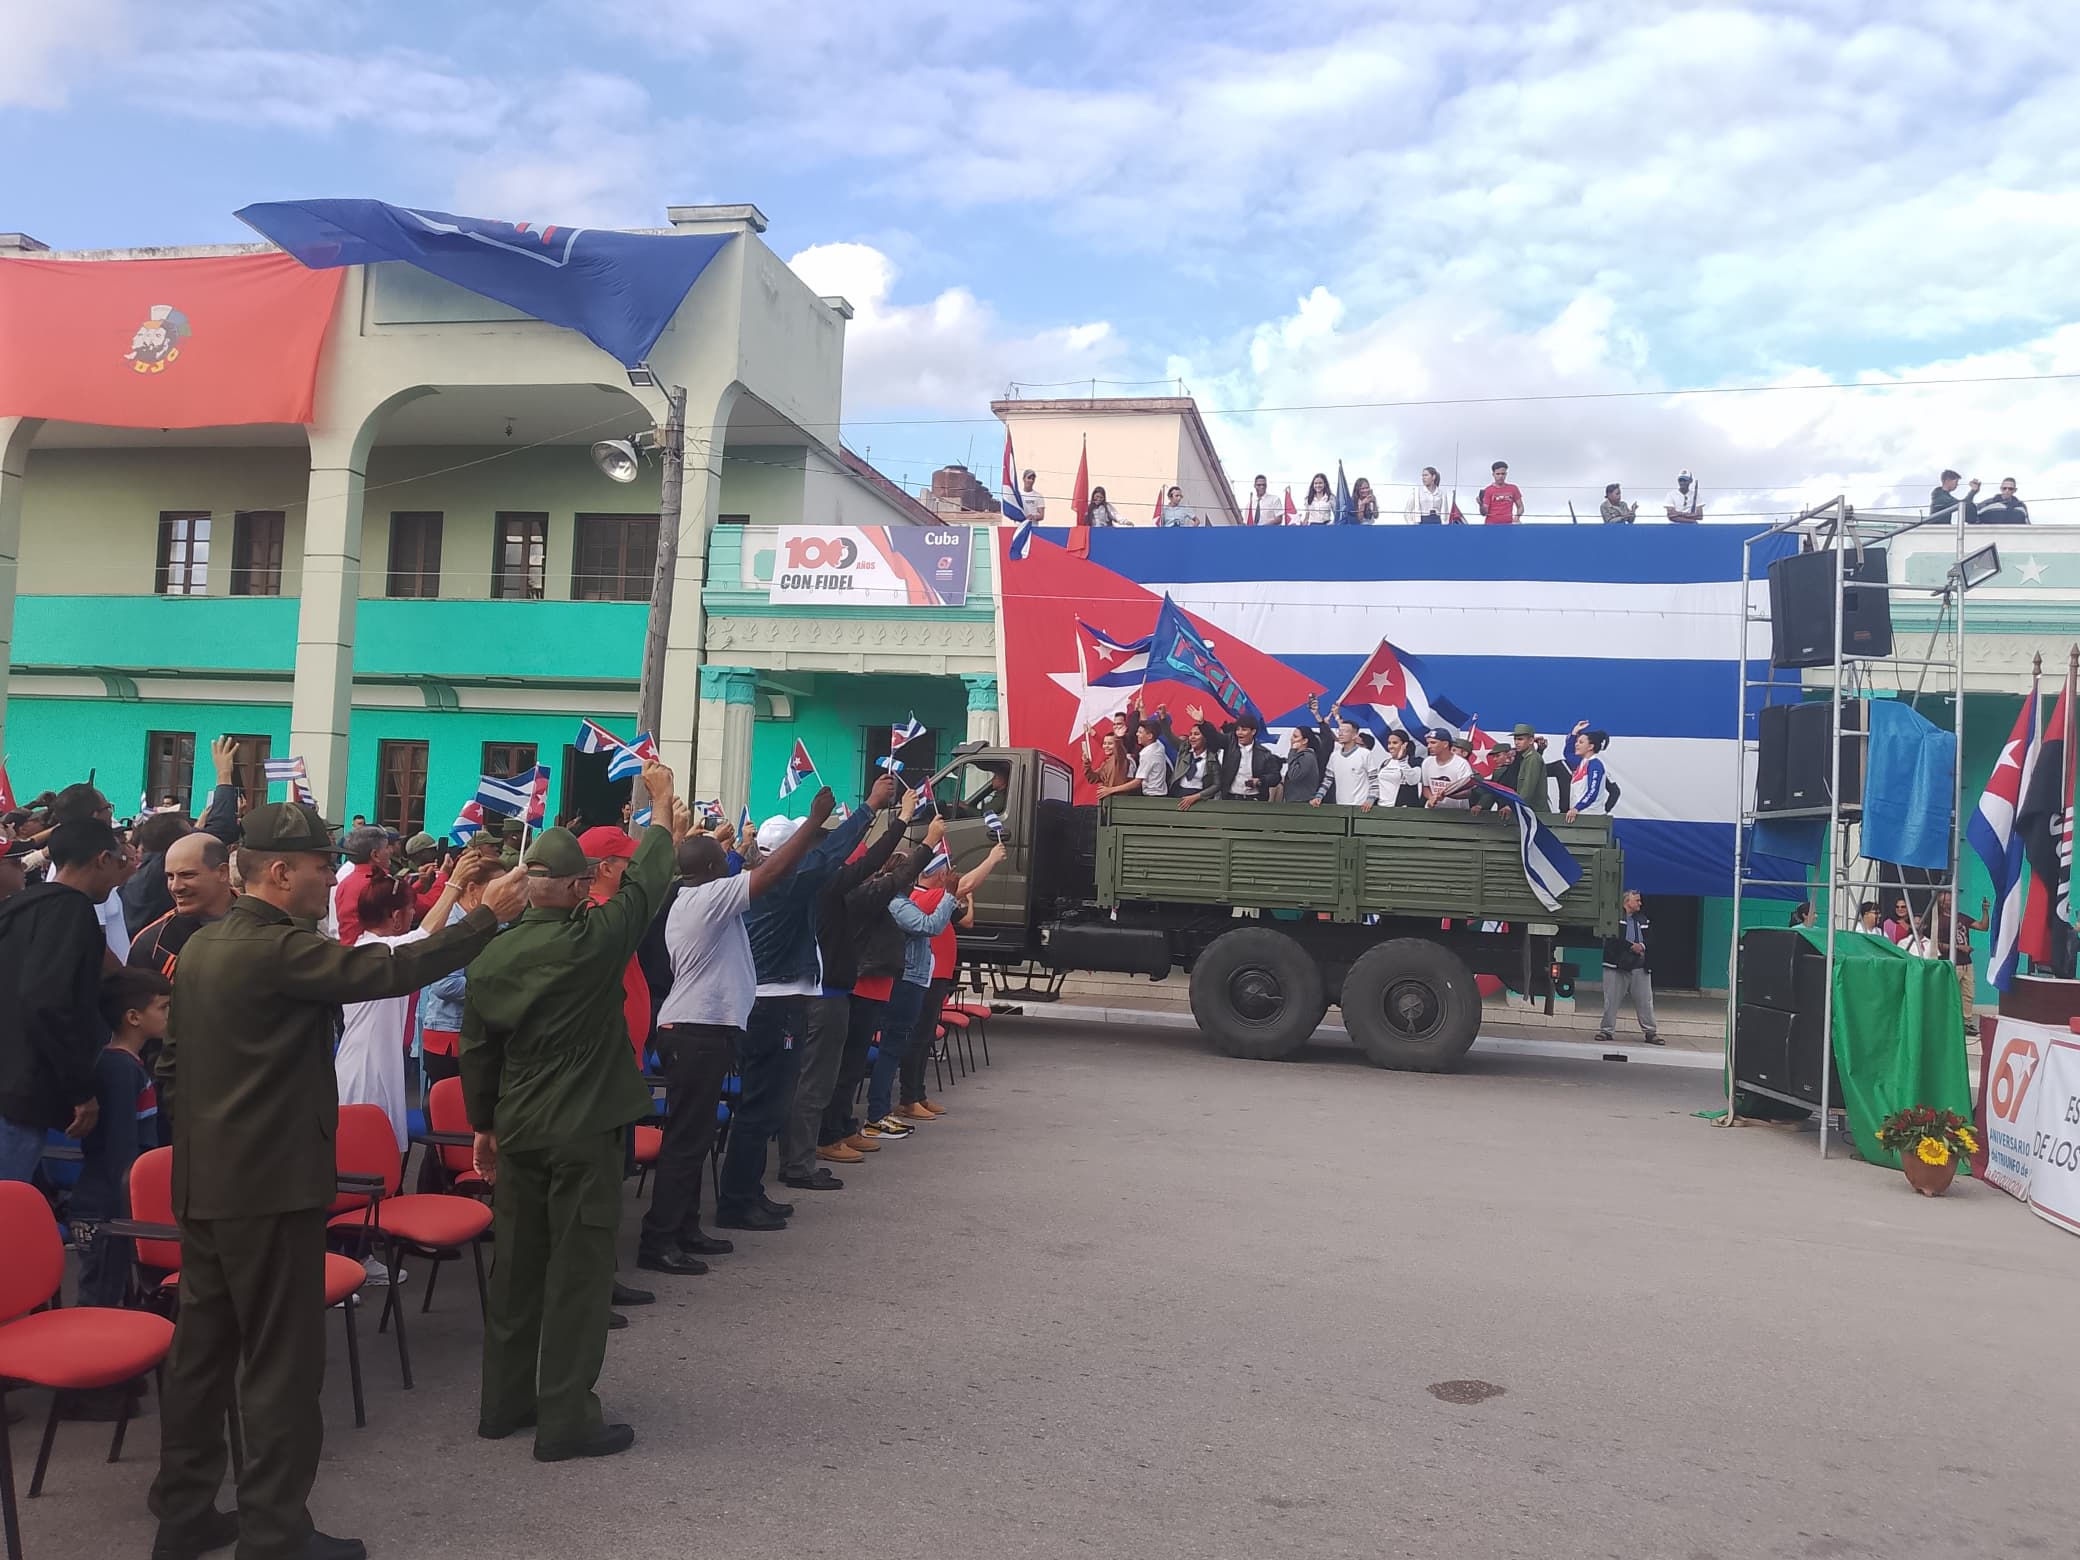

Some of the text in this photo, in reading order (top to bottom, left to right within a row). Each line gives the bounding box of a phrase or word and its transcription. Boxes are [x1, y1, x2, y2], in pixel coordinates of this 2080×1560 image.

[924, 531, 959, 546] Cuba
[785, 536, 858, 570] 100
[856, 560, 876, 570] AÑOS
[780, 574, 855, 590] CON FIDEL
[1991, 1038, 2040, 1124] 67
[1990, 1128, 2030, 1157] ANIVERSARIO
[2033, 1130, 2080, 1172] DE LOS
[2020, 1163, 2029, 1178] de
